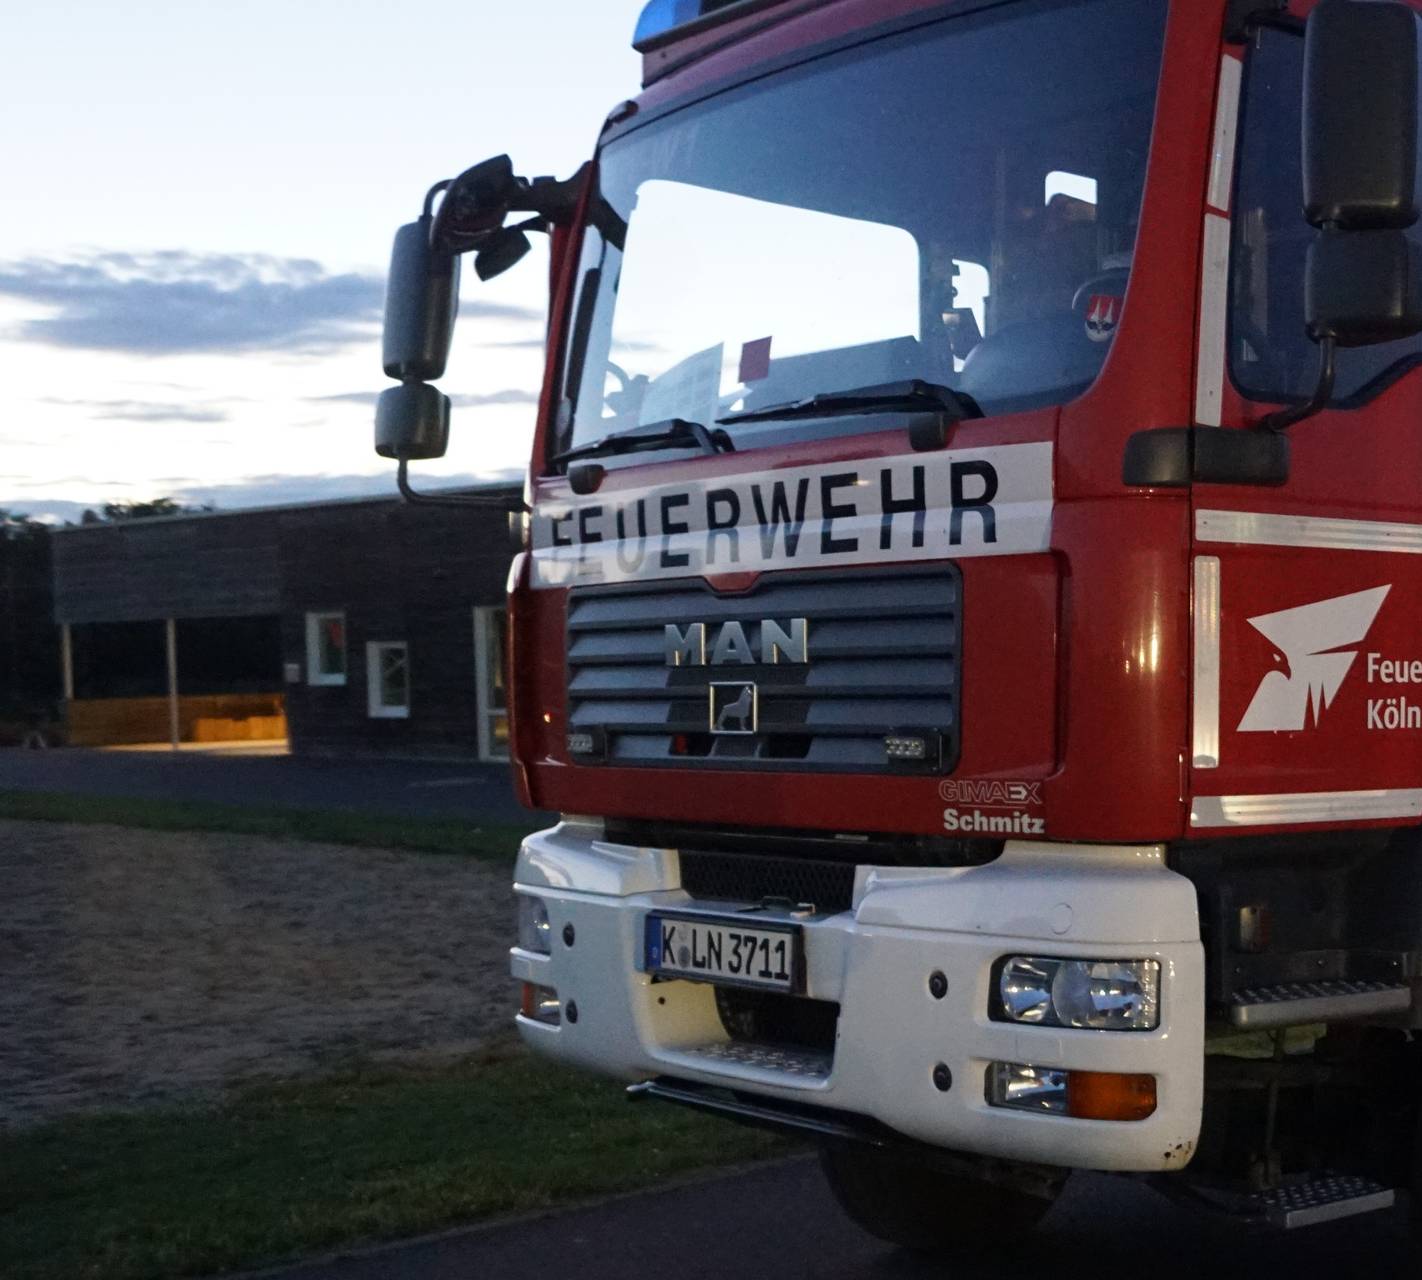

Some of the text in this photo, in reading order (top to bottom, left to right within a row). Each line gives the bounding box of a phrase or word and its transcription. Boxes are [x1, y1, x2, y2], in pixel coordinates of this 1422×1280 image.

[550, 459, 999, 577] FEUERWEHR
[664, 617, 808, 666] MAN
[1367, 697, 1421, 730] Köln
[938, 780, 1042, 804] GIMAEX
[943, 808, 1045, 834] Schmitz
[662, 925, 790, 980] K LN 3711
